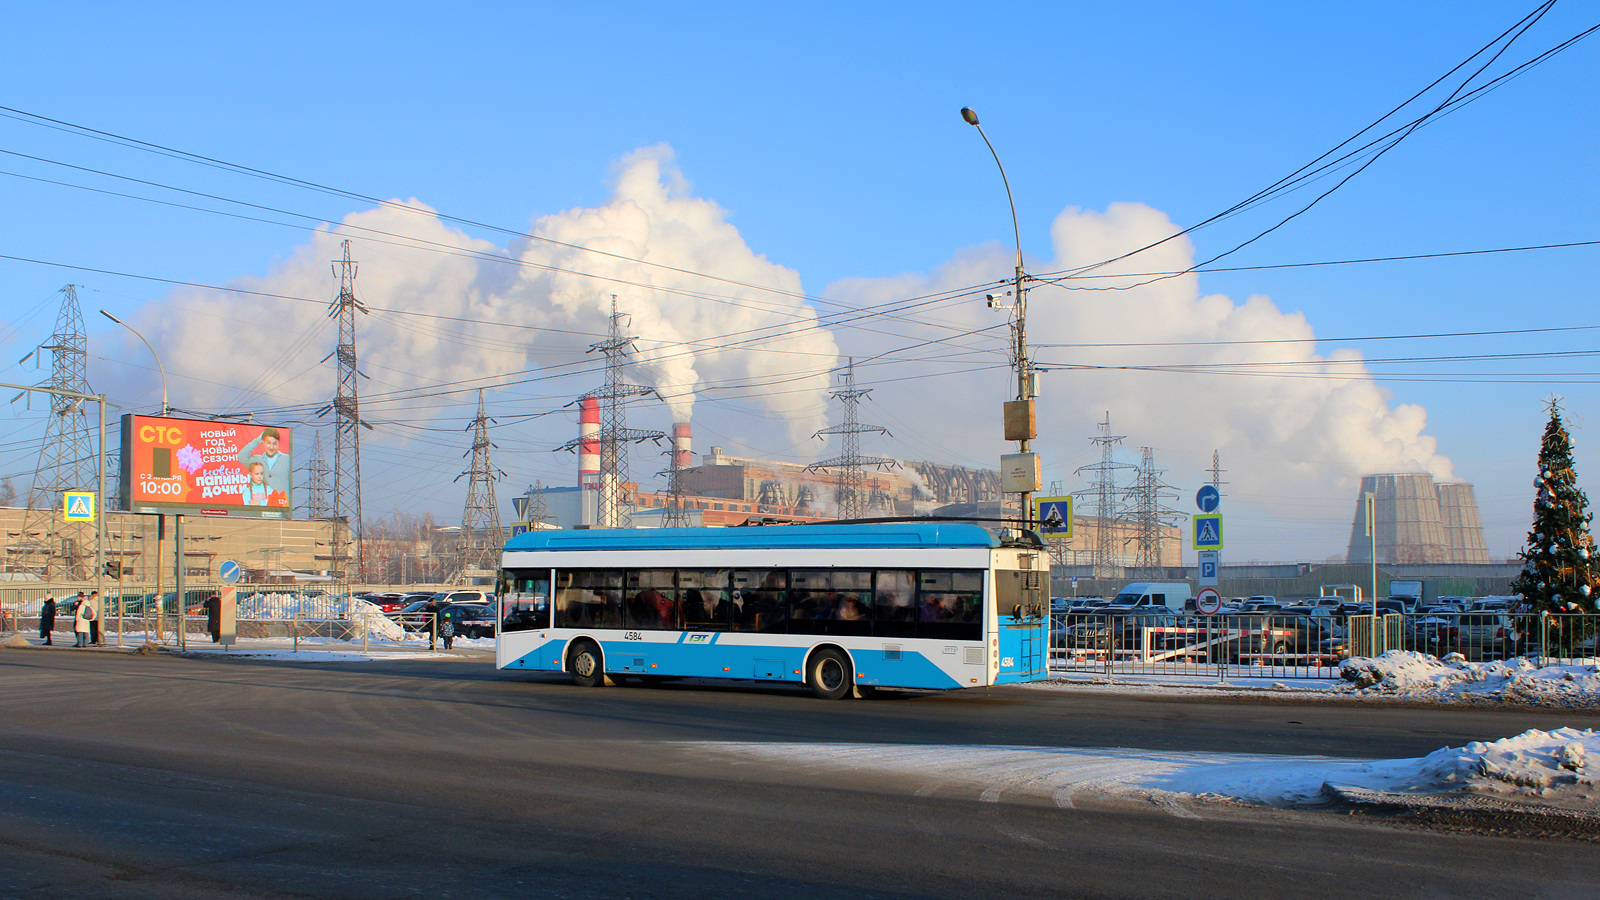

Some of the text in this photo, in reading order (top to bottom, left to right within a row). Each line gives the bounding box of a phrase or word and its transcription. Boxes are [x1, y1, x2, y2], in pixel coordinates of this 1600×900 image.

[139, 425, 182, 444] СТС
[200, 428, 236, 438] НОВЫЙ
[205, 438, 226, 446] ГОД
[202, 444, 238, 454] НОВЫЙ
[202, 454, 238, 463] СЕЗОН!
[140, 482, 182, 495] 10:00
[1205, 564, 1212, 576] P
[624, 632, 642, 641] 4584
[1001, 657, 1015, 667] 4584
